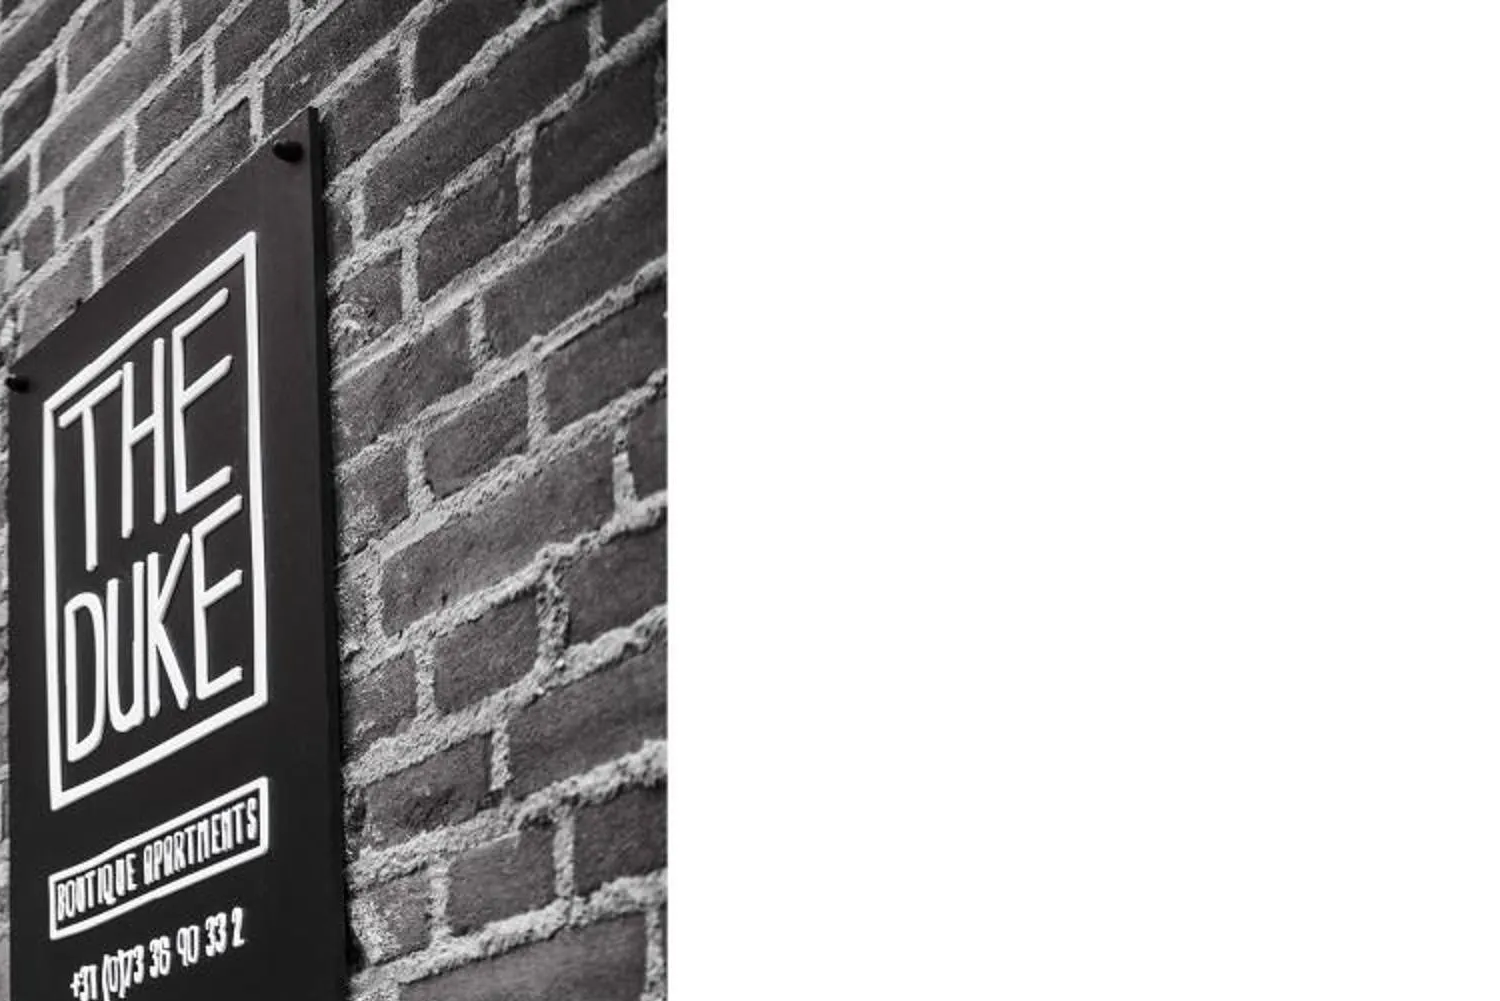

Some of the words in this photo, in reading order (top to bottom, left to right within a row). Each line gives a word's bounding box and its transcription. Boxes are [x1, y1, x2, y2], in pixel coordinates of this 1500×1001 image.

[58, 287, 233, 572] THE
[63, 494, 243, 763] DUKE
[56, 852, 138, 922] BOUTIQUE
[143, 797, 258, 886] APARTMENTS
[148, 935, 172, 979] 36
[176, 924, 201, 967] 90
[204, 911, 228, 957] 33
[230, 906, 245, 948] 2
